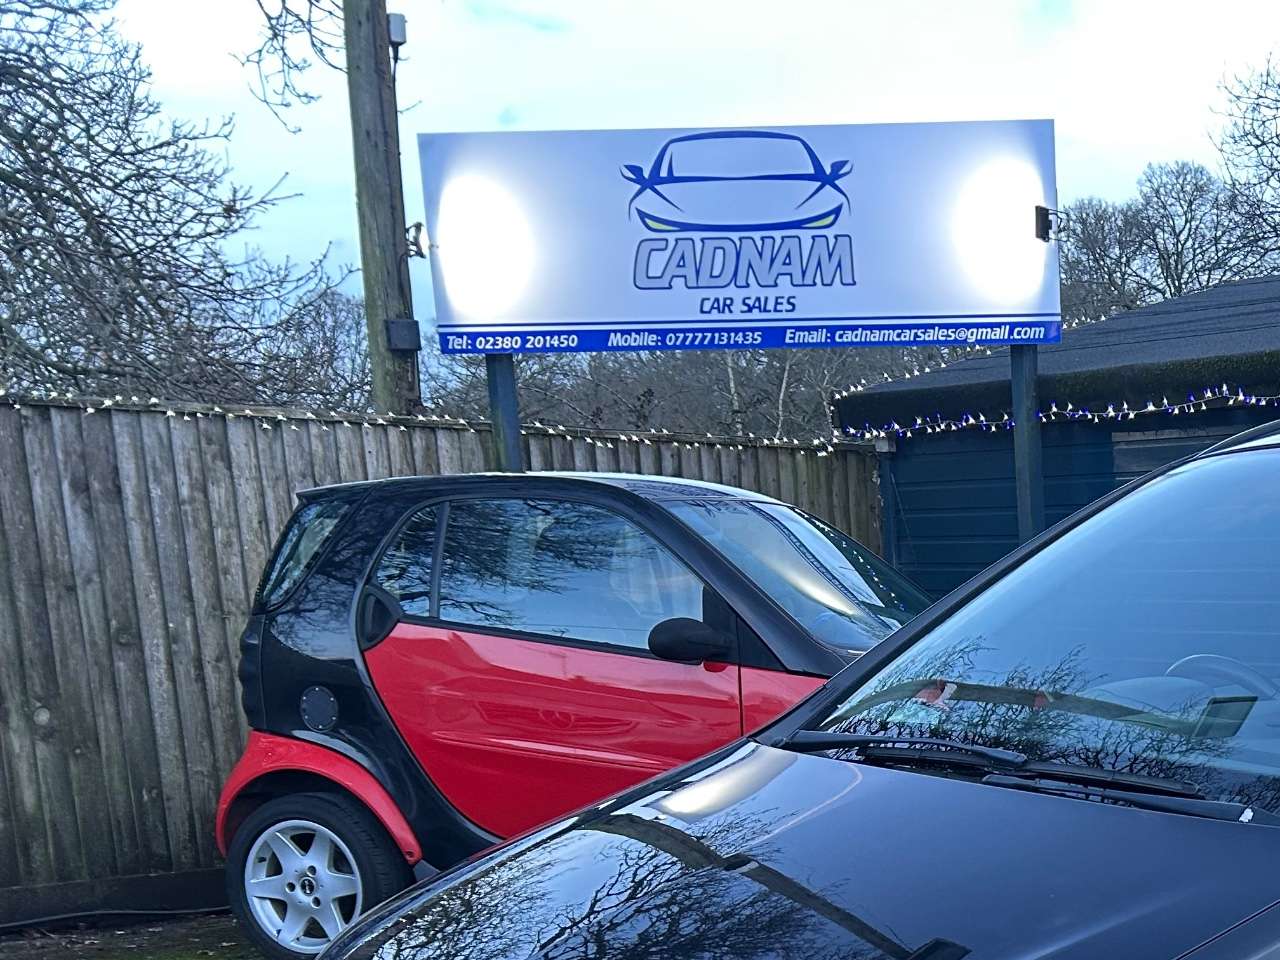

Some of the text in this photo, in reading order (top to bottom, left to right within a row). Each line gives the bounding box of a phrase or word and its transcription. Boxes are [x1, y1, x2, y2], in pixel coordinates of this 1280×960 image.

[633, 234, 857, 290] CADNAM
[700, 295, 797, 314] CAR SALES
[447, 323, 1045, 350] Tel: 02380 201450 Mobile: 07777131435 Email: cadnamcarsales@gmail.com
